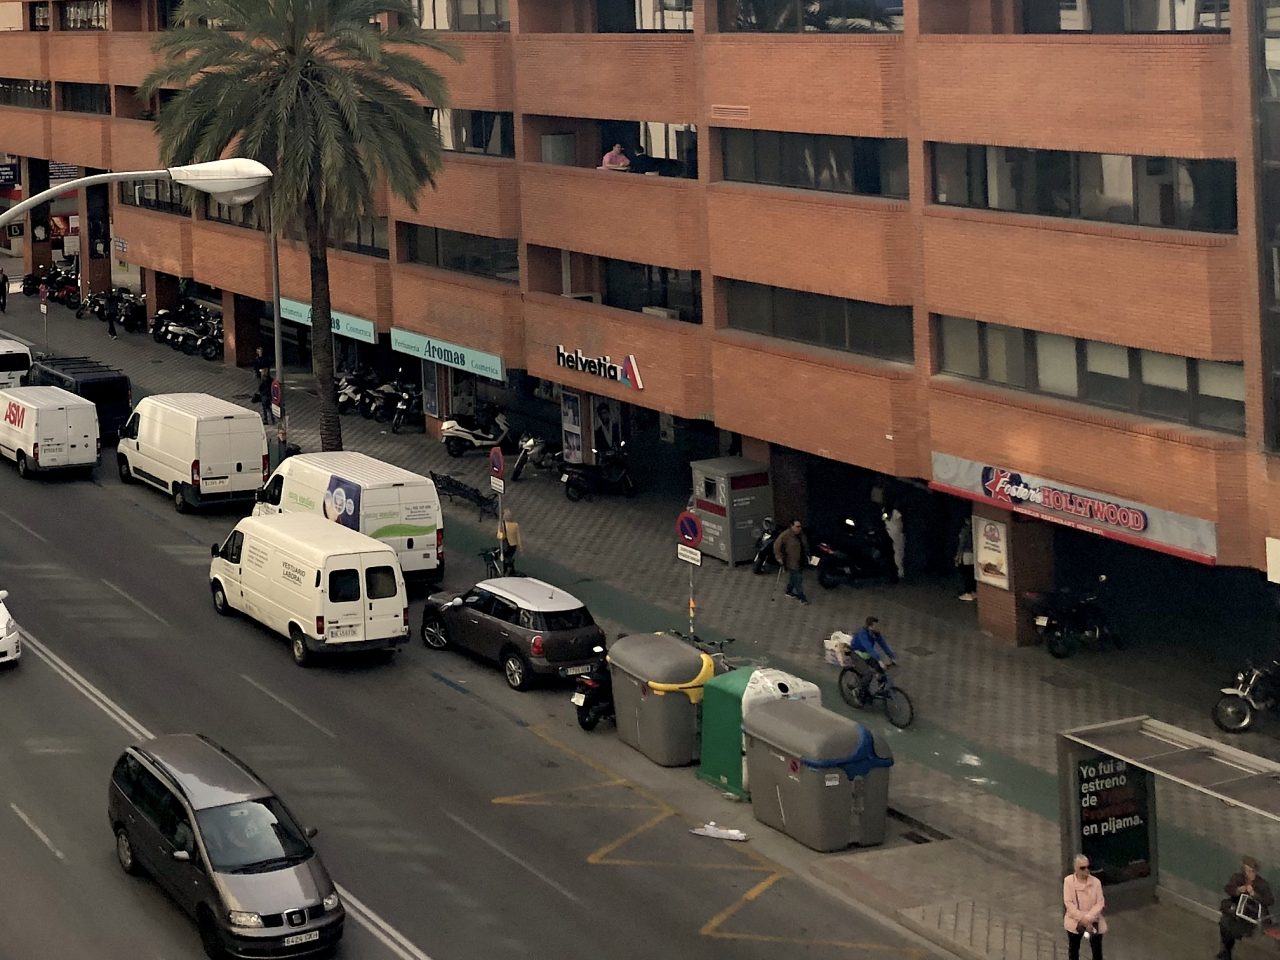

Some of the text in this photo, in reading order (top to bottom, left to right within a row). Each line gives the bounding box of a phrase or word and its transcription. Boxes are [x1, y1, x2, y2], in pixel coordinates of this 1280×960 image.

[424, 340, 466, 367] Aromas
[556, 344, 621, 381] helvetia
[995, 477, 1147, 531] Foster's HOLLYWOOD
[1079, 765, 1096, 779] Yo
[1098, 760, 1114, 775] fui
[1081, 775, 1127, 794] estreno
[1081, 793, 1098, 807] de
[1082, 814, 1144, 836] en pijama.
